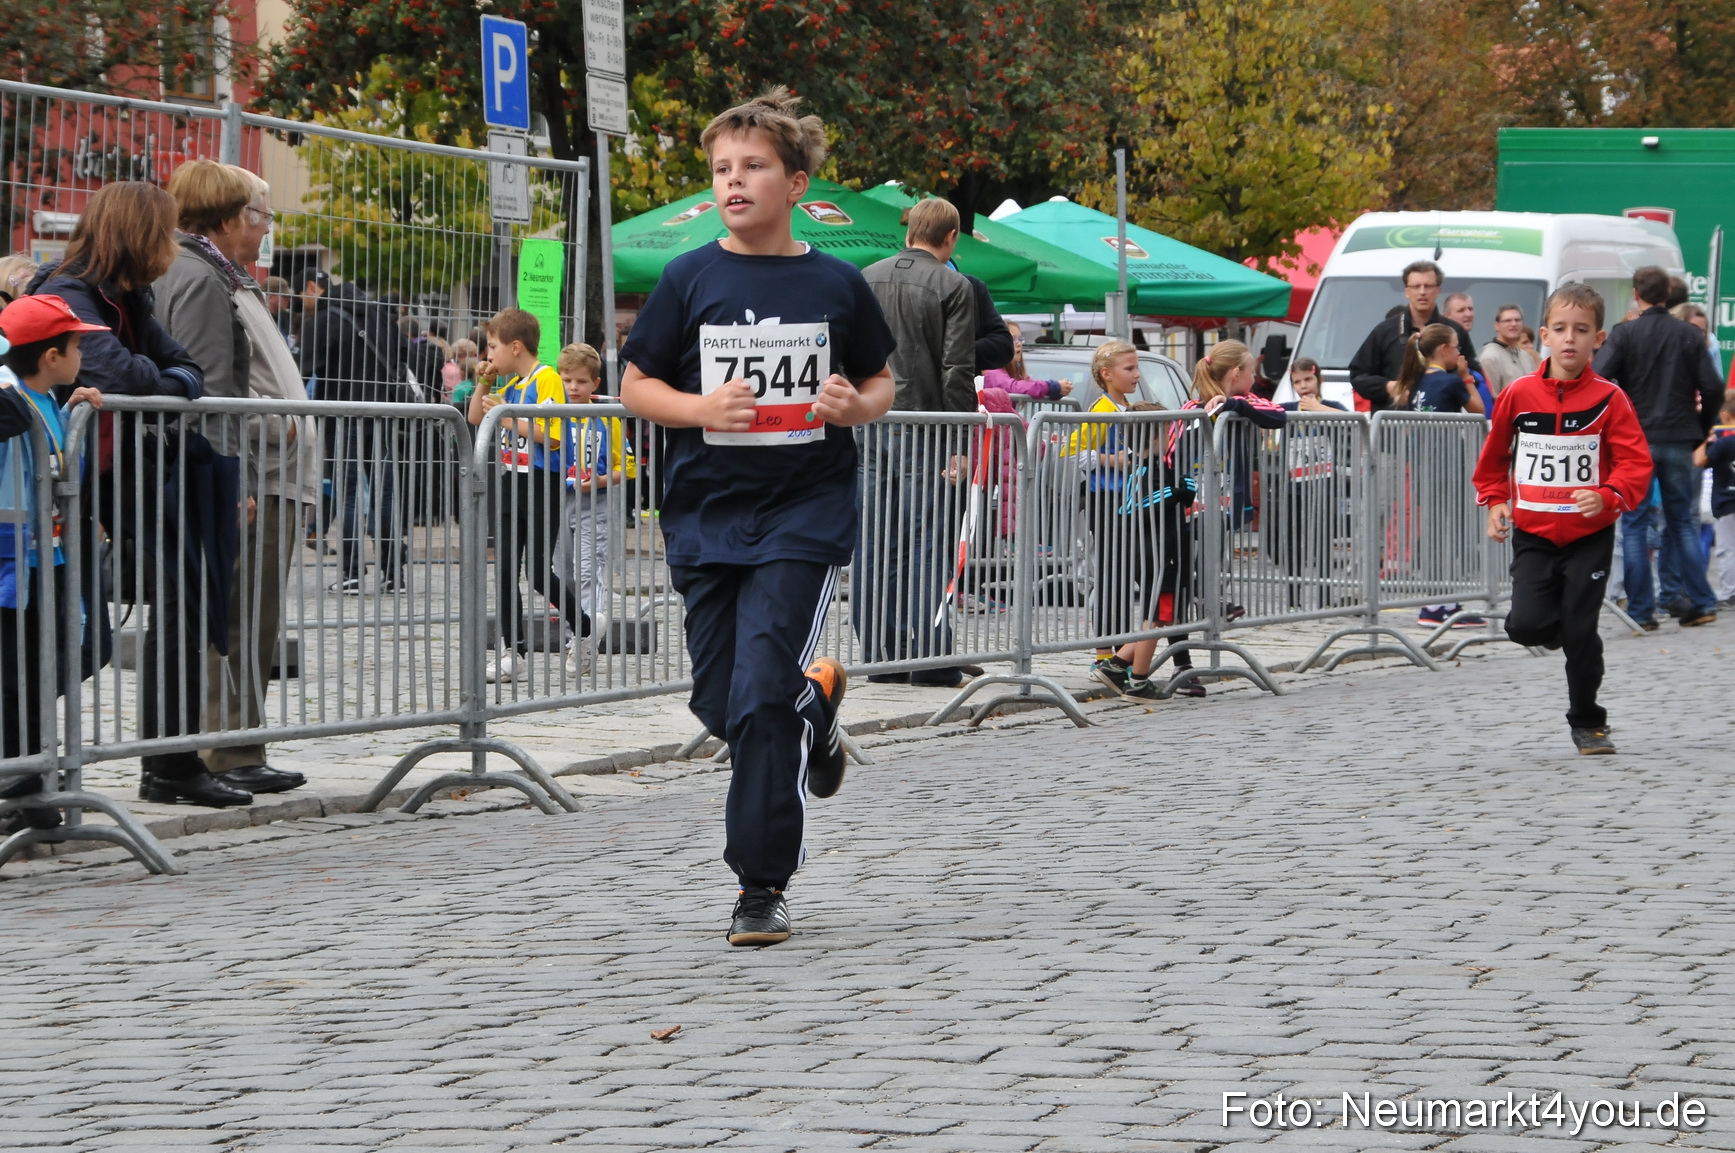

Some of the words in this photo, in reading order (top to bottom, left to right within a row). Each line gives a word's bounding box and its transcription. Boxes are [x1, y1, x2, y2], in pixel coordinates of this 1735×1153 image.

[590, 12, 618, 30] werktags
[588, 47, 596, 60] Sa
[492, 31, 517, 112] P
[1437, 227, 1500, 236] Europcar
[1484, 238, 1504, 246] way
[703, 337, 746, 349] PARTL
[750, 336, 811, 348] Neumarkt
[715, 354, 820, 399] 7544
[755, 410, 783, 426] Leo
[1564, 419, 1580, 428] L.F.
[787, 428, 814, 438] 2005
[1520, 441, 1543, 450] PARTL
[1545, 442, 1586, 451] Neumarkt
[1526, 453, 1593, 483] 7518
